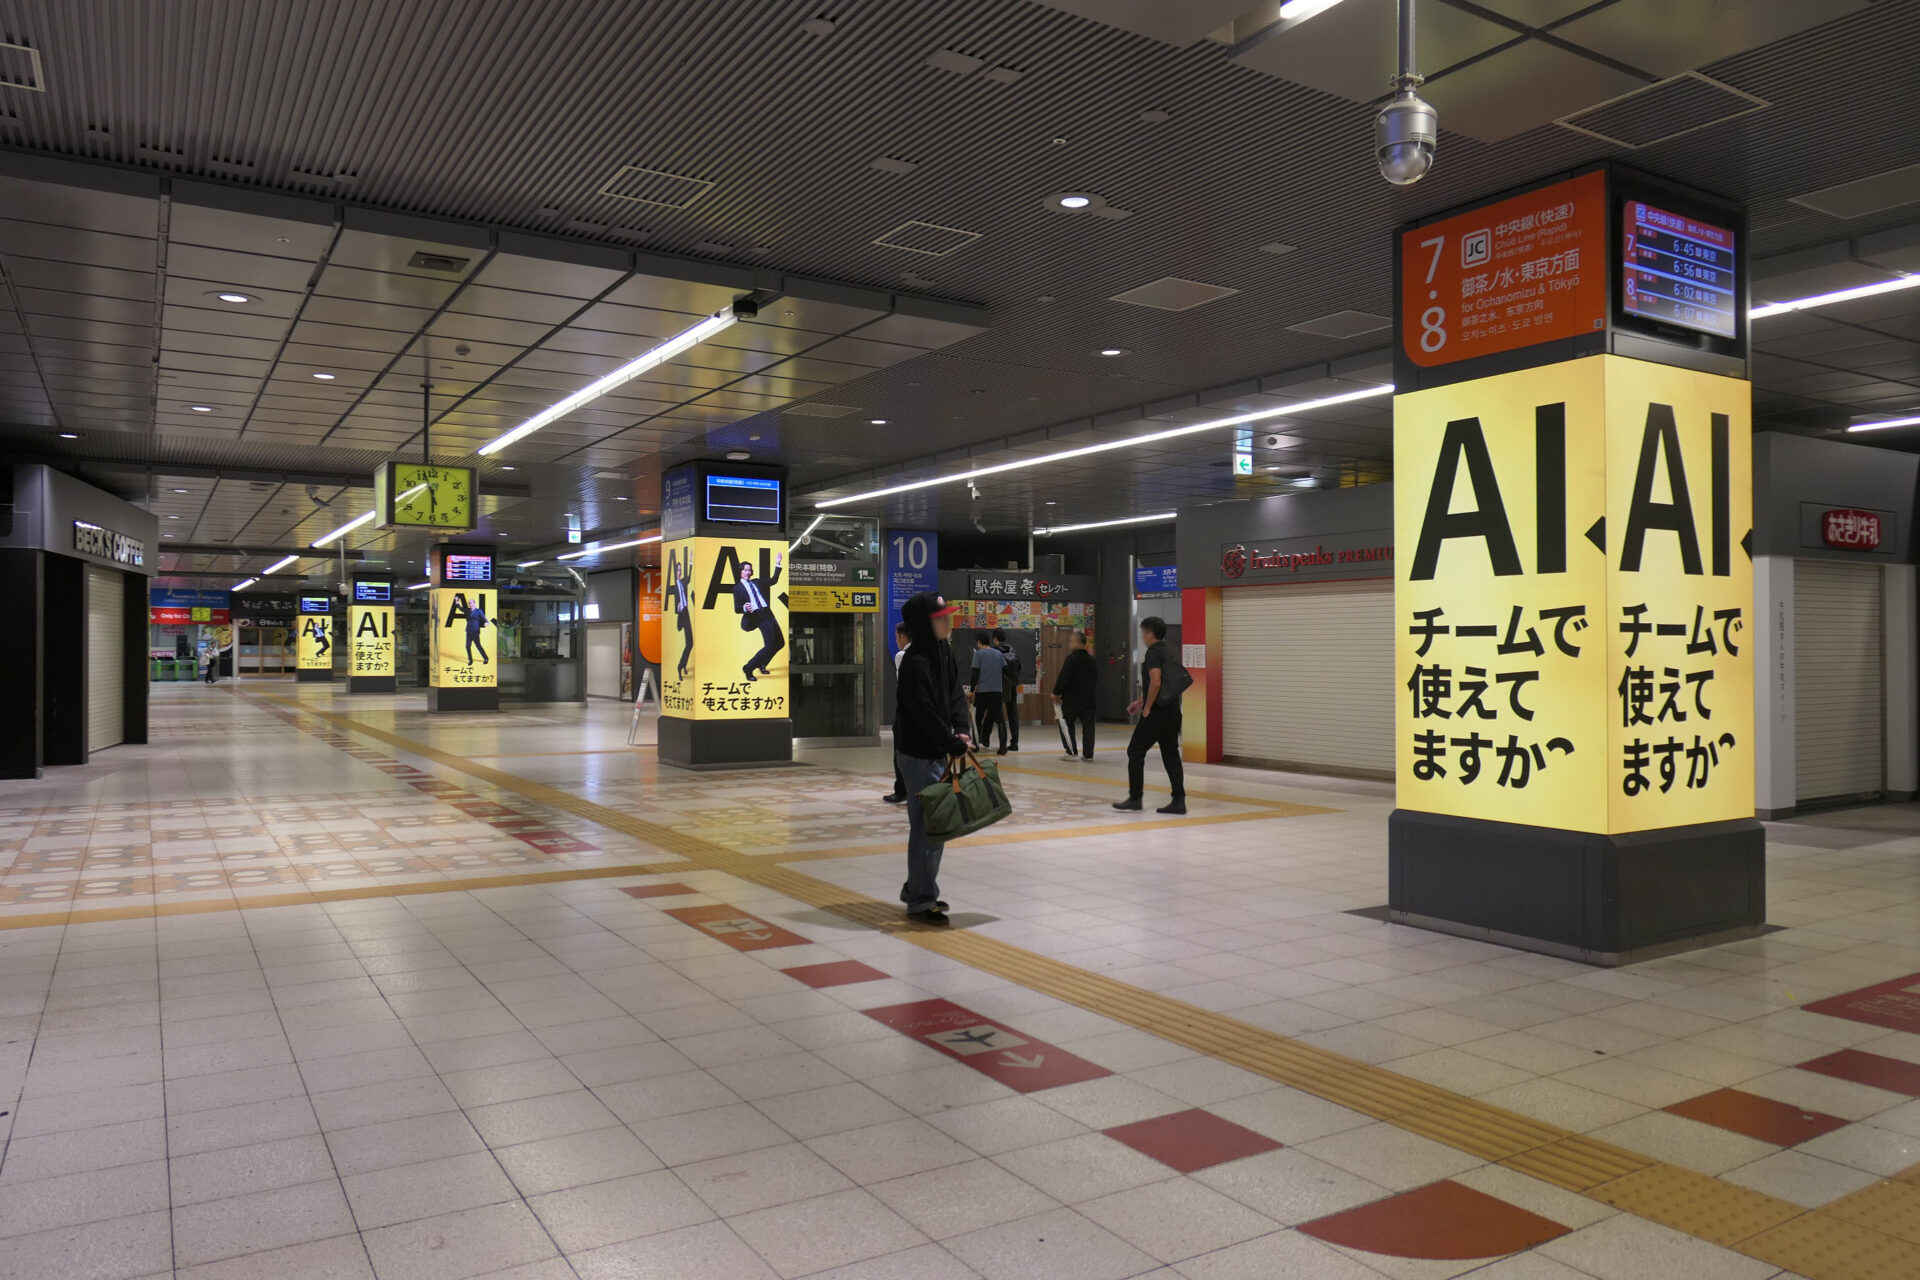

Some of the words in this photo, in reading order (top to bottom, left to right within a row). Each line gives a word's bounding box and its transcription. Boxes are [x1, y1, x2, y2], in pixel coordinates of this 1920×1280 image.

[1495, 202, 1575, 238] 中央線(快速)
[1468, 239, 1485, 257] JC
[1626, 234, 1635, 252] 7
[1673, 240, 1695, 257] 6:45
[1420, 235, 1445, 285] 7
[1461, 248, 1580, 299] 御茶ノ水・東京方面
[1673, 260, 1695, 278] 6:56
[1461, 302, 1475, 313] for
[1476, 287, 1536, 310] Ochanomizu
[1537, 283, 1545, 294] &
[1626, 278, 1635, 296] 8
[1673, 283, 1695, 300] 6:02
[1420, 306, 1447, 352] 8
[1409, 402, 1567, 581] AI
[1619, 402, 1730, 577] AI
[893, 536, 928, 569] 10
[1250, 549, 1290, 569] fruits
[1290, 545, 1334, 573] peaks
[702, 545, 771, 614] AI
[974, 579, 1018, 594] 駅弁屋
[356, 612, 388, 638] AI
[1409, 605, 1588, 658] チームで
[1618, 602, 1743, 658] チームで
[702, 682, 752, 696] チームで
[1407, 664, 1540, 721] 使えて
[1617, 665, 1715, 727] 使えて
